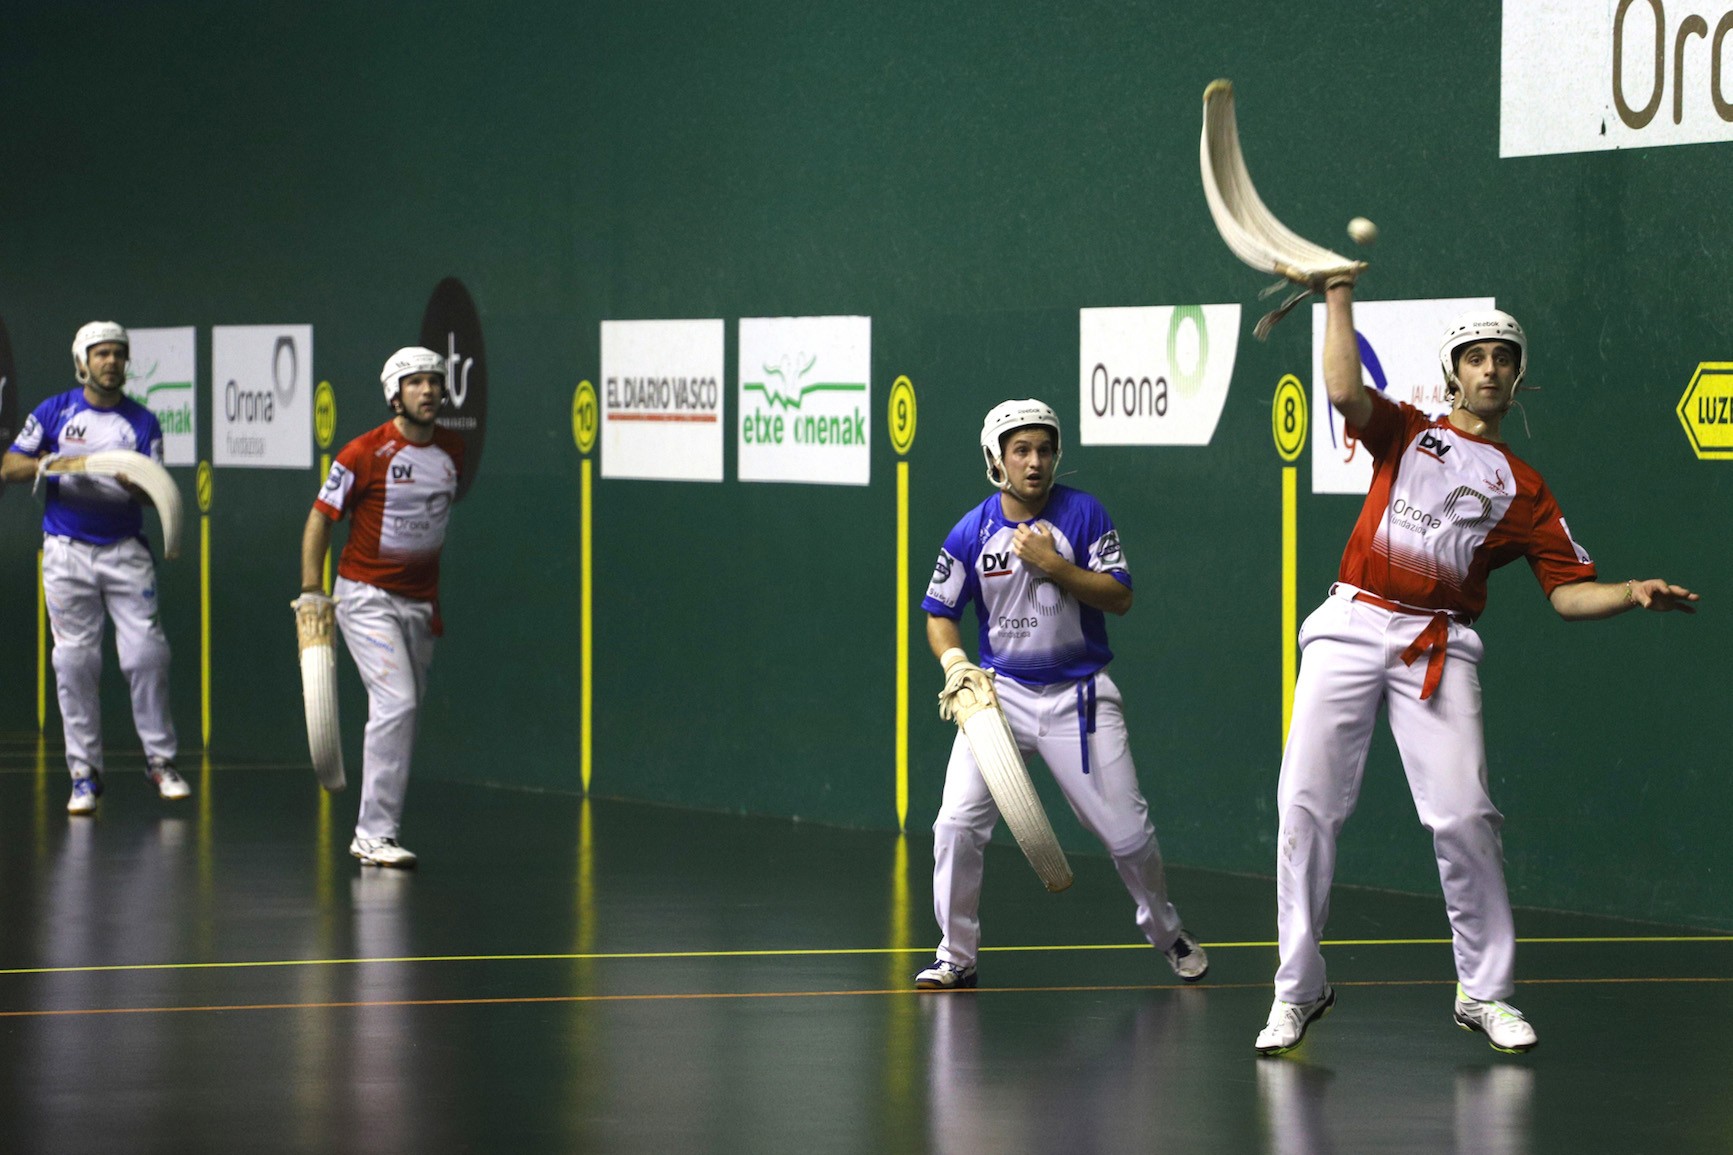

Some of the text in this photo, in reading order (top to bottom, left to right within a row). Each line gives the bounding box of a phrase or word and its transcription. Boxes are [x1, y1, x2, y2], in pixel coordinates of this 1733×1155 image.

[225, 380, 273, 424] Orona
[607, 377, 717, 410] EL DIARIO VASCO
[1091, 363, 1168, 417] Orona
[577, 402, 593, 431] 10
[743, 406, 866, 445] etxe onenak
[898, 399, 907, 432] 9
[1284, 397, 1296, 433] 8
[65, 426, 87, 438] DV
[1419, 432, 1451, 457] DV
[392, 464, 413, 478] DV
[1392, 498, 1442, 530] Orona
[983, 552, 1010, 571] DV
